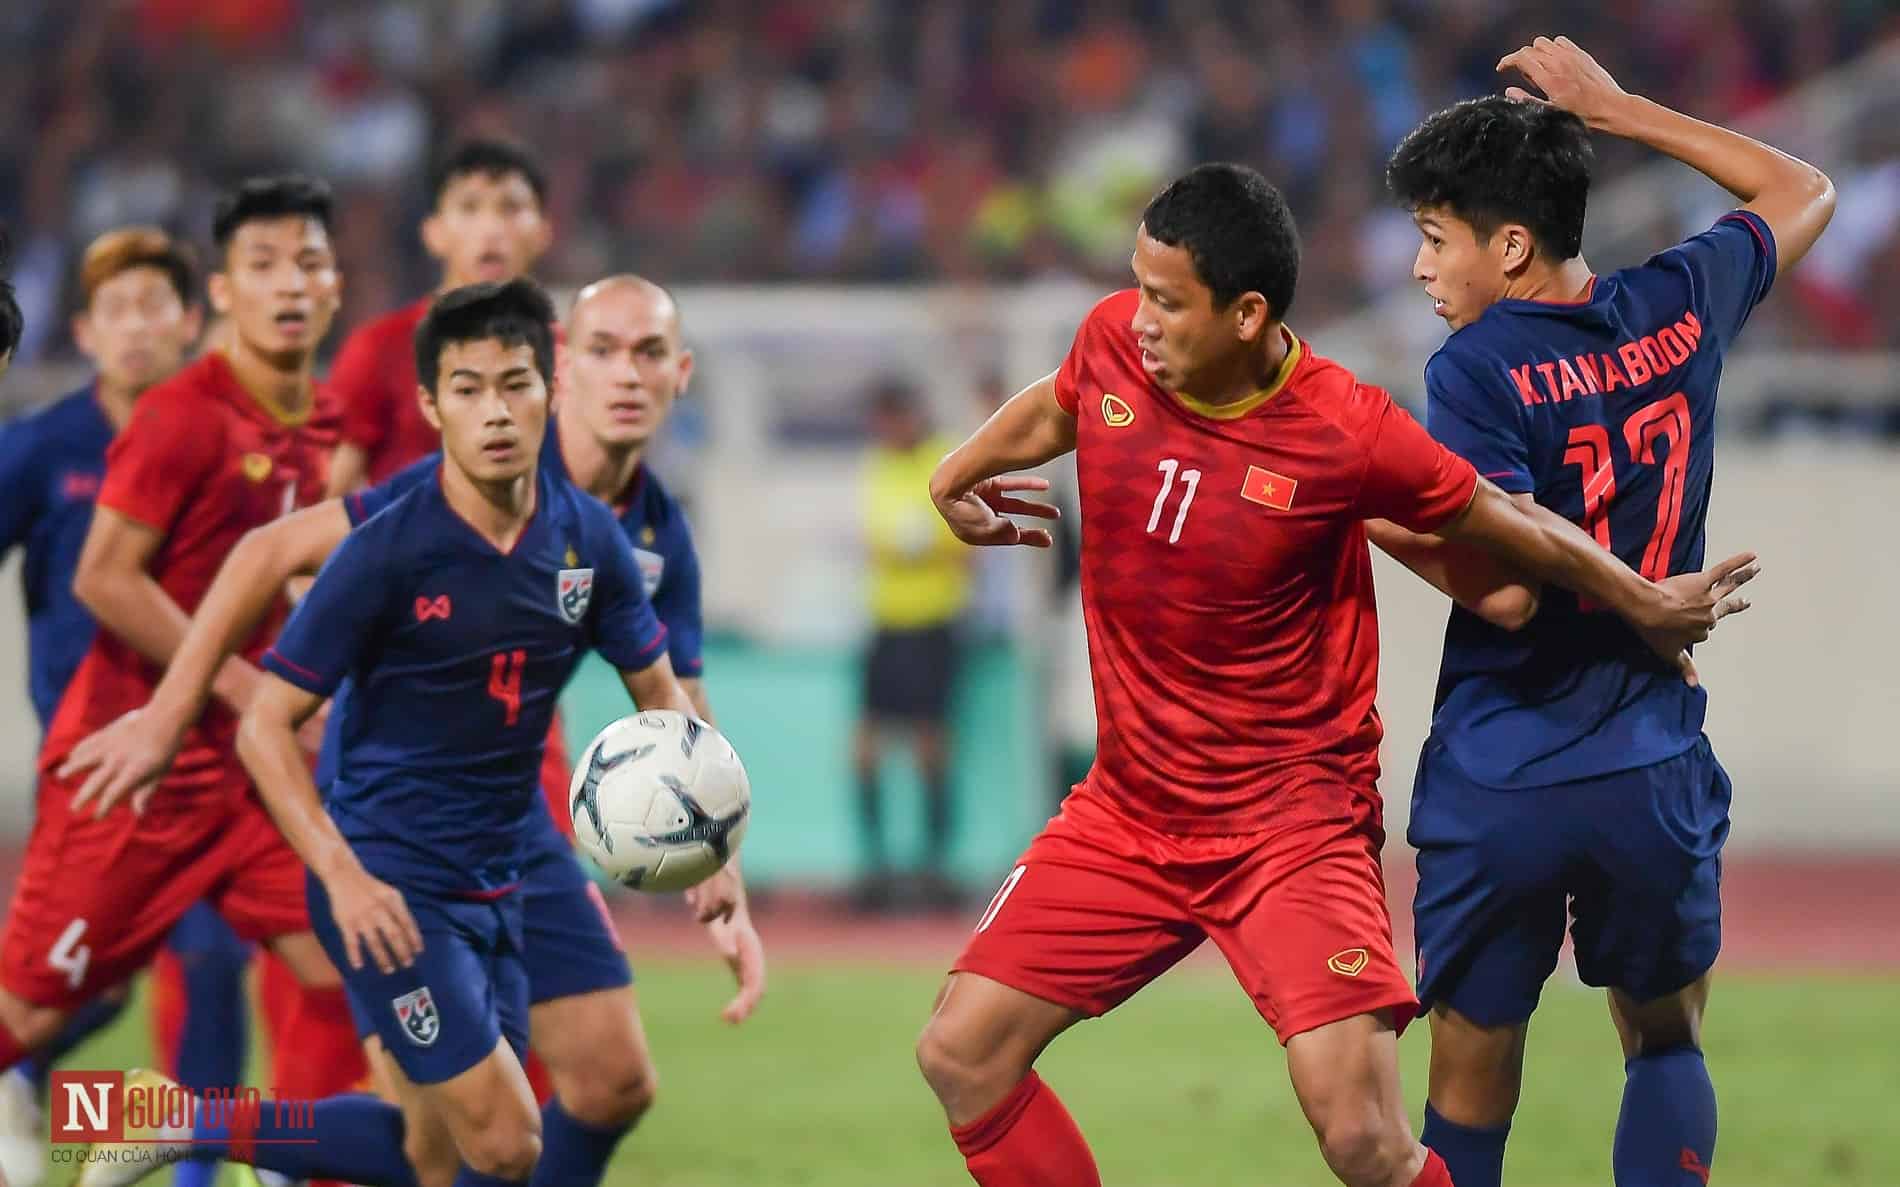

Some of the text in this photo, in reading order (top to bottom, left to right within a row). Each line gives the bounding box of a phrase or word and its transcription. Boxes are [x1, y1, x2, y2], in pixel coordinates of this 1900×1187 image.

[1510, 311, 1702, 406] K.TANABOON
[1146, 458, 1202, 545] 11
[1563, 391, 1692, 584] 17
[487, 648, 527, 727] 4
[47, 917, 92, 989] 4
